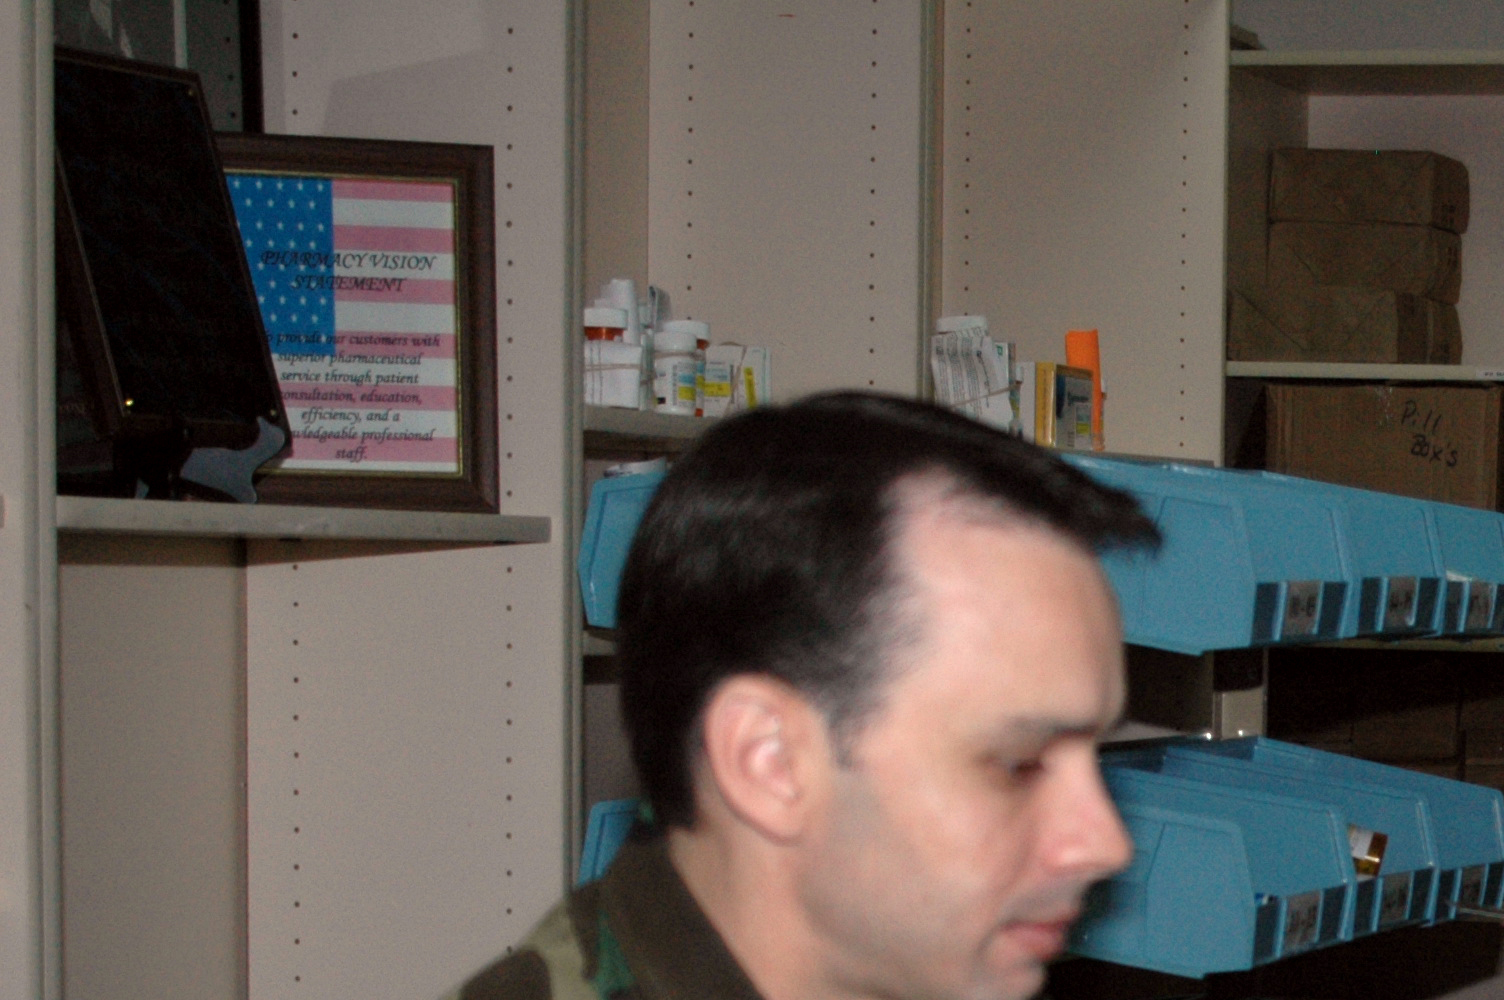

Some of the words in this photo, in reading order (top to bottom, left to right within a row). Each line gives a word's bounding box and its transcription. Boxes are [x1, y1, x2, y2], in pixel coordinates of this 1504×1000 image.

[262, 250, 367, 269] PHARMACY
[369, 252, 437, 271] VISION
[291, 274, 407, 292] STATEMENT
[276, 330, 323, 346] provide
[350, 333, 408, 347] customers
[412, 332, 440, 347] with
[277, 351, 327, 366] superior
[328, 351, 424, 367] pharmaceutical
[280, 370, 321, 382] service
[325, 368, 372, 386] through
[375, 370, 419, 385] patient
[281, 387, 356, 403] onsultation,
[360, 392, 422, 405] education,
[302, 406, 362, 425] efficiency,
[366, 408, 389, 422] and
[392, 412, 400, 422] a
[1401, 400, 1442, 435] Pill
[291, 425, 358, 443] wledgeable
[361, 428, 437, 445] professional
[335, 445, 367, 463] staff.
